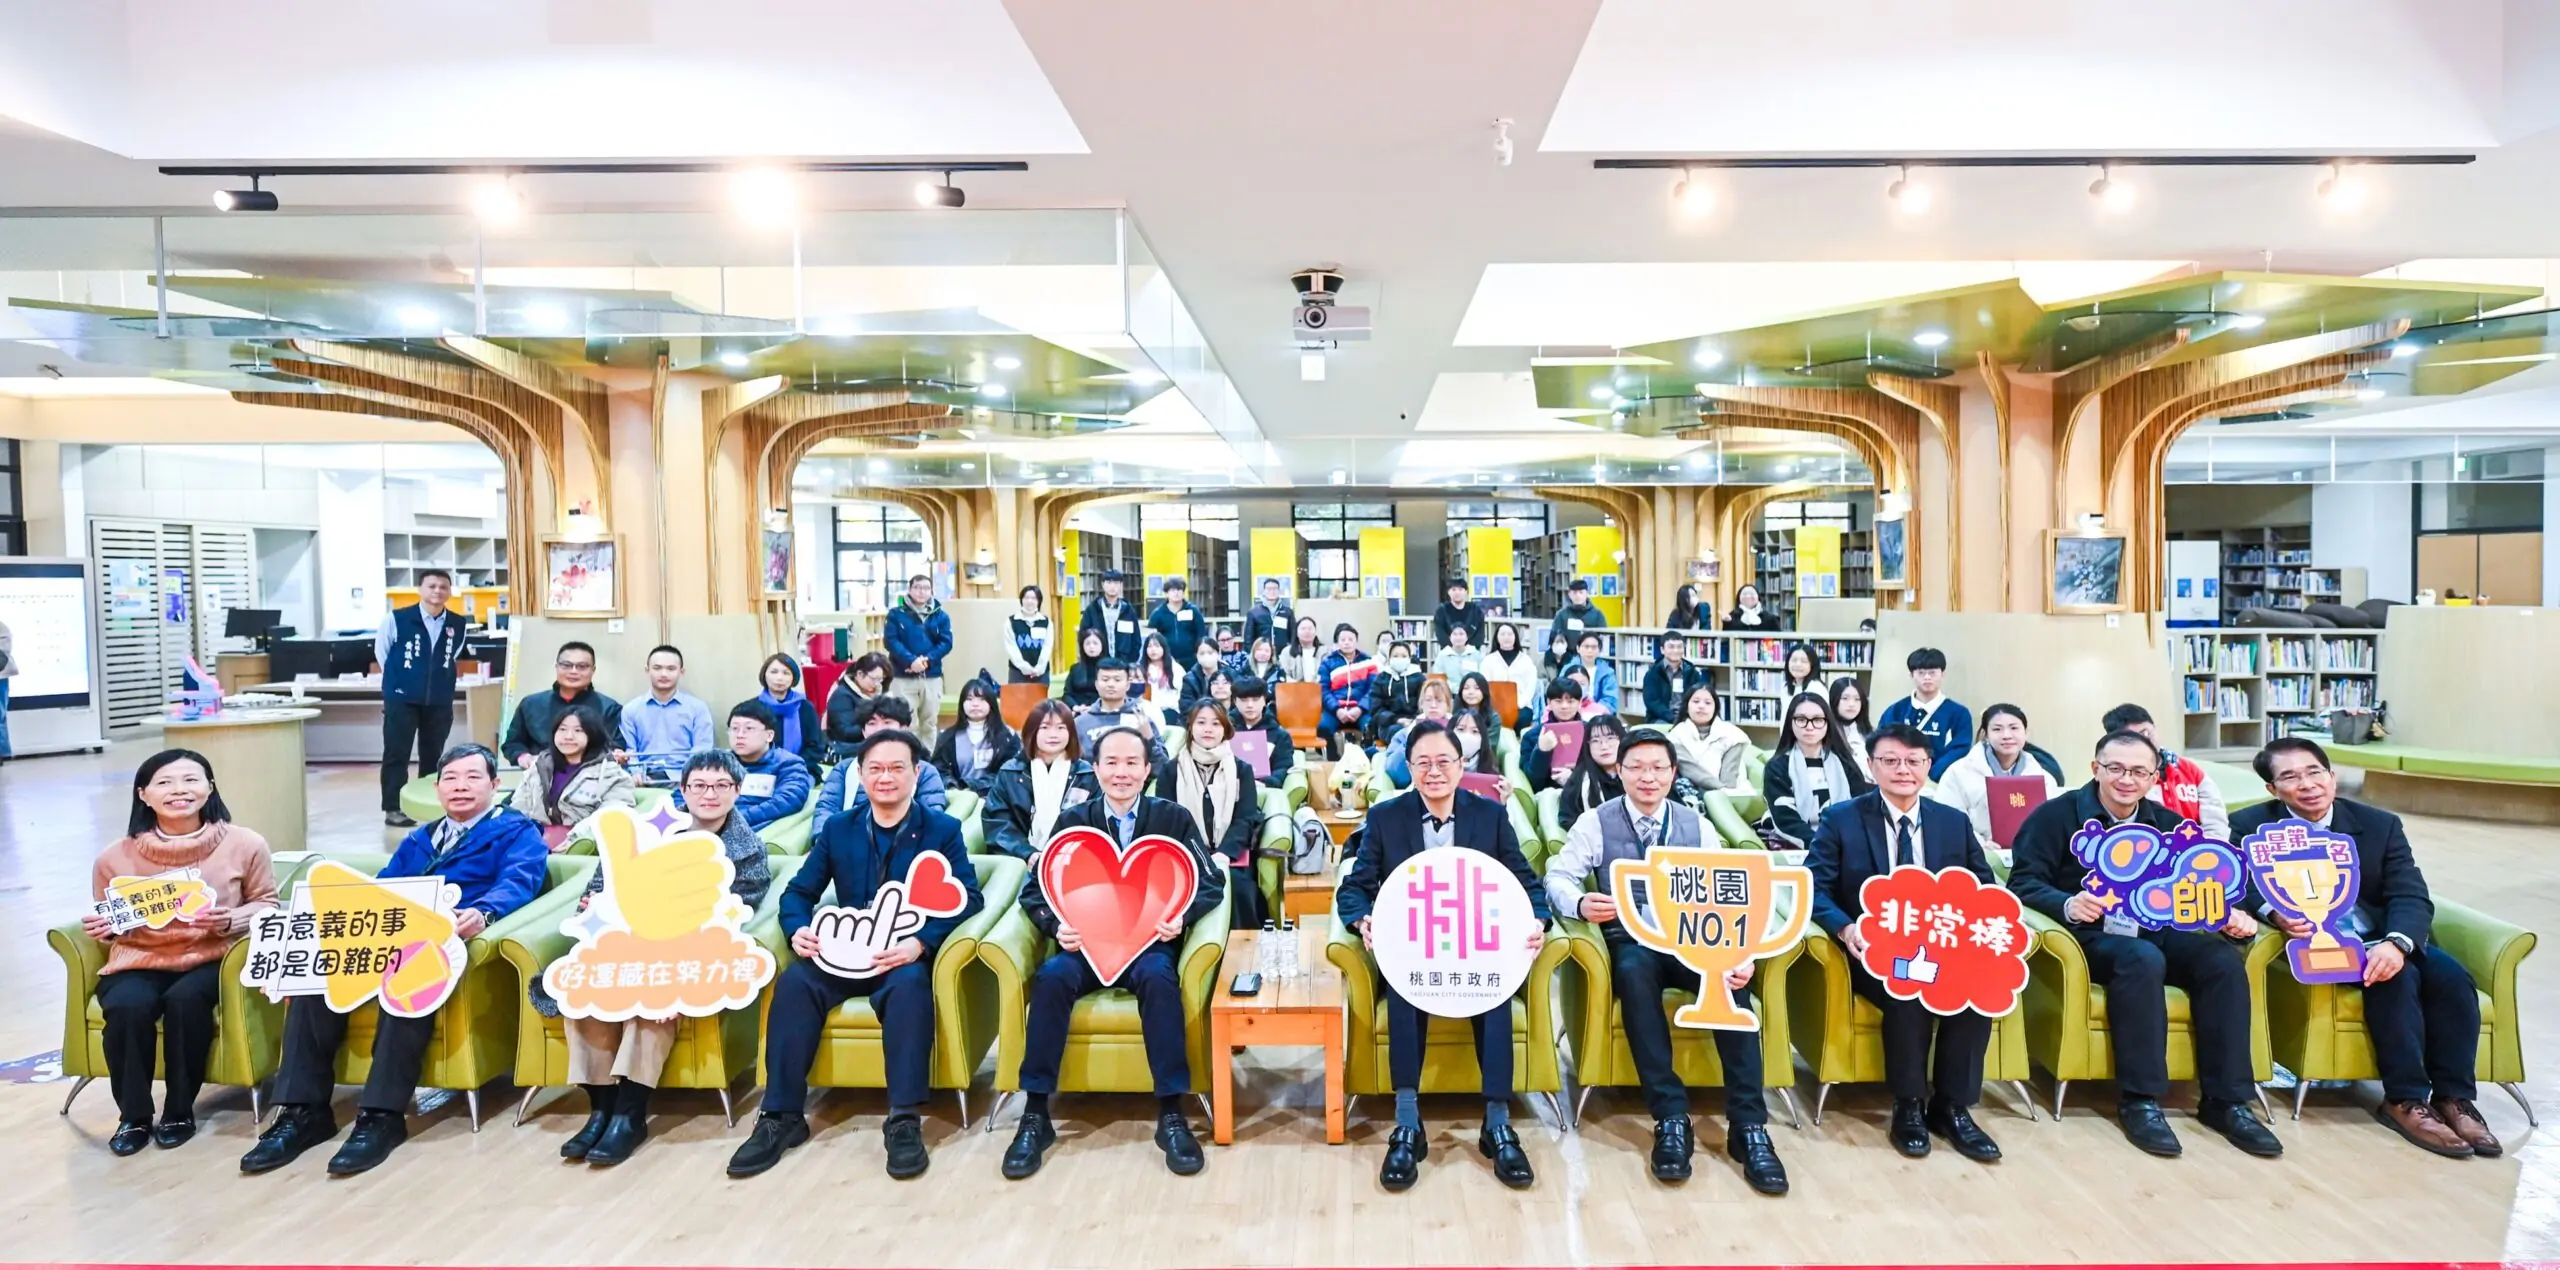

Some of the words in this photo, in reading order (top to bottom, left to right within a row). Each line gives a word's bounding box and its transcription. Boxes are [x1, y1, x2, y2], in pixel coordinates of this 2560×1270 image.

[2176, 784, 2198, 803] 09
[2252, 828, 2350, 864] 我是第一名
[94, 882, 177, 915] 有意義的事
[1669, 865, 1749, 906] 桃園
[2171, 876, 2226, 926] 帥
[257, 907, 408, 943] 有意義的事
[1677, 910, 1748, 949] NO.1
[1878, 897, 2016, 958] 非常棒
[249, 945, 403, 981] 都是困難的
[557, 956, 760, 992] 好運藏在努力裡
[1409, 971, 1501, 988] 桃園市政府
